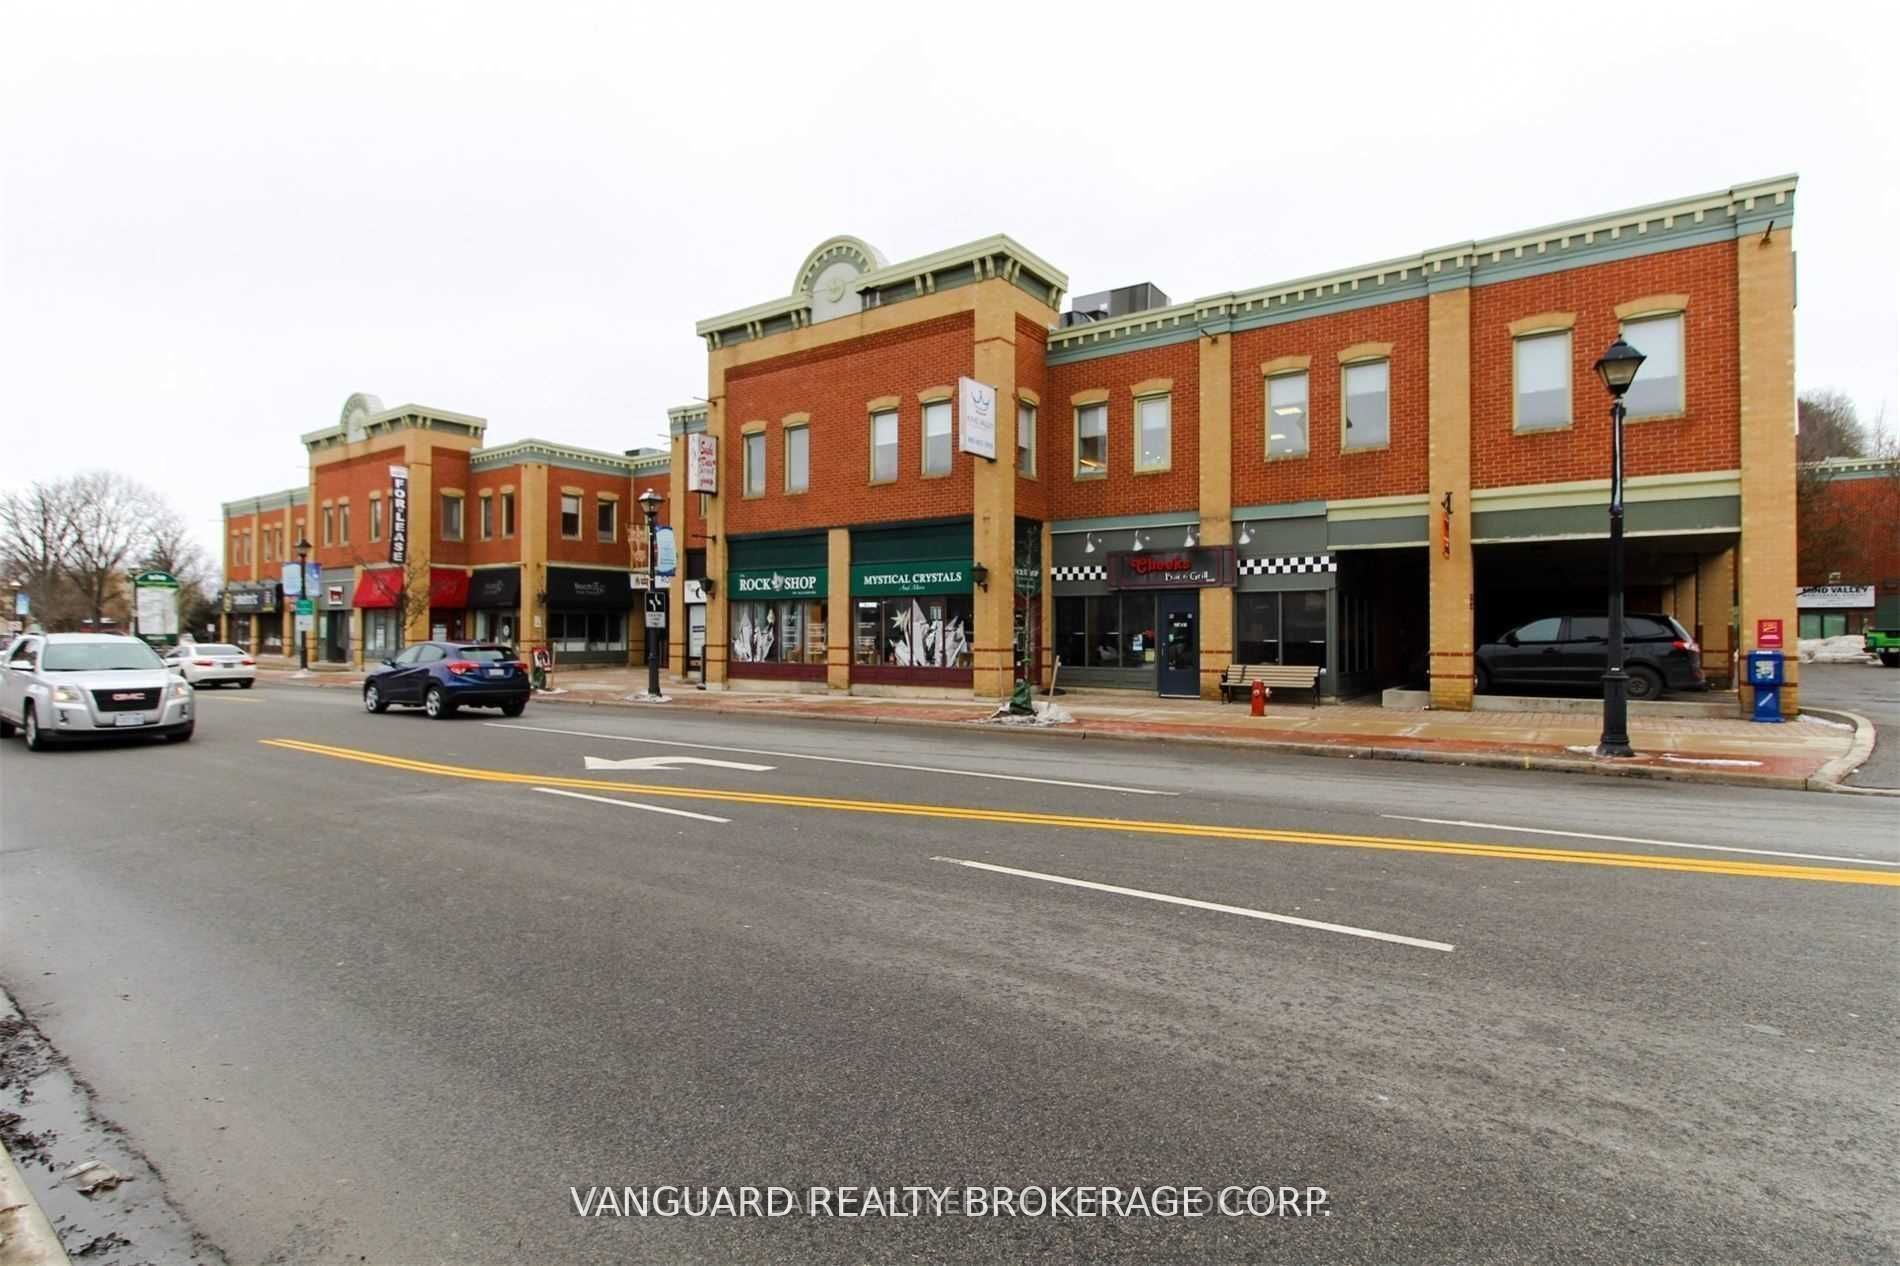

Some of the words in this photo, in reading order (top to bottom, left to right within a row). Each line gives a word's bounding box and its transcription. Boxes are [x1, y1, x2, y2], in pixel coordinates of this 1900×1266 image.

[394, 478, 406, 509] FOR
[393, 511, 406, 562] LEASE
[739, 578, 772, 592] ROCK
[784, 576, 817, 590] SHOP
[863, 574, 911, 585] MYSTICAL
[912, 572, 962, 583] CRYSTALS
